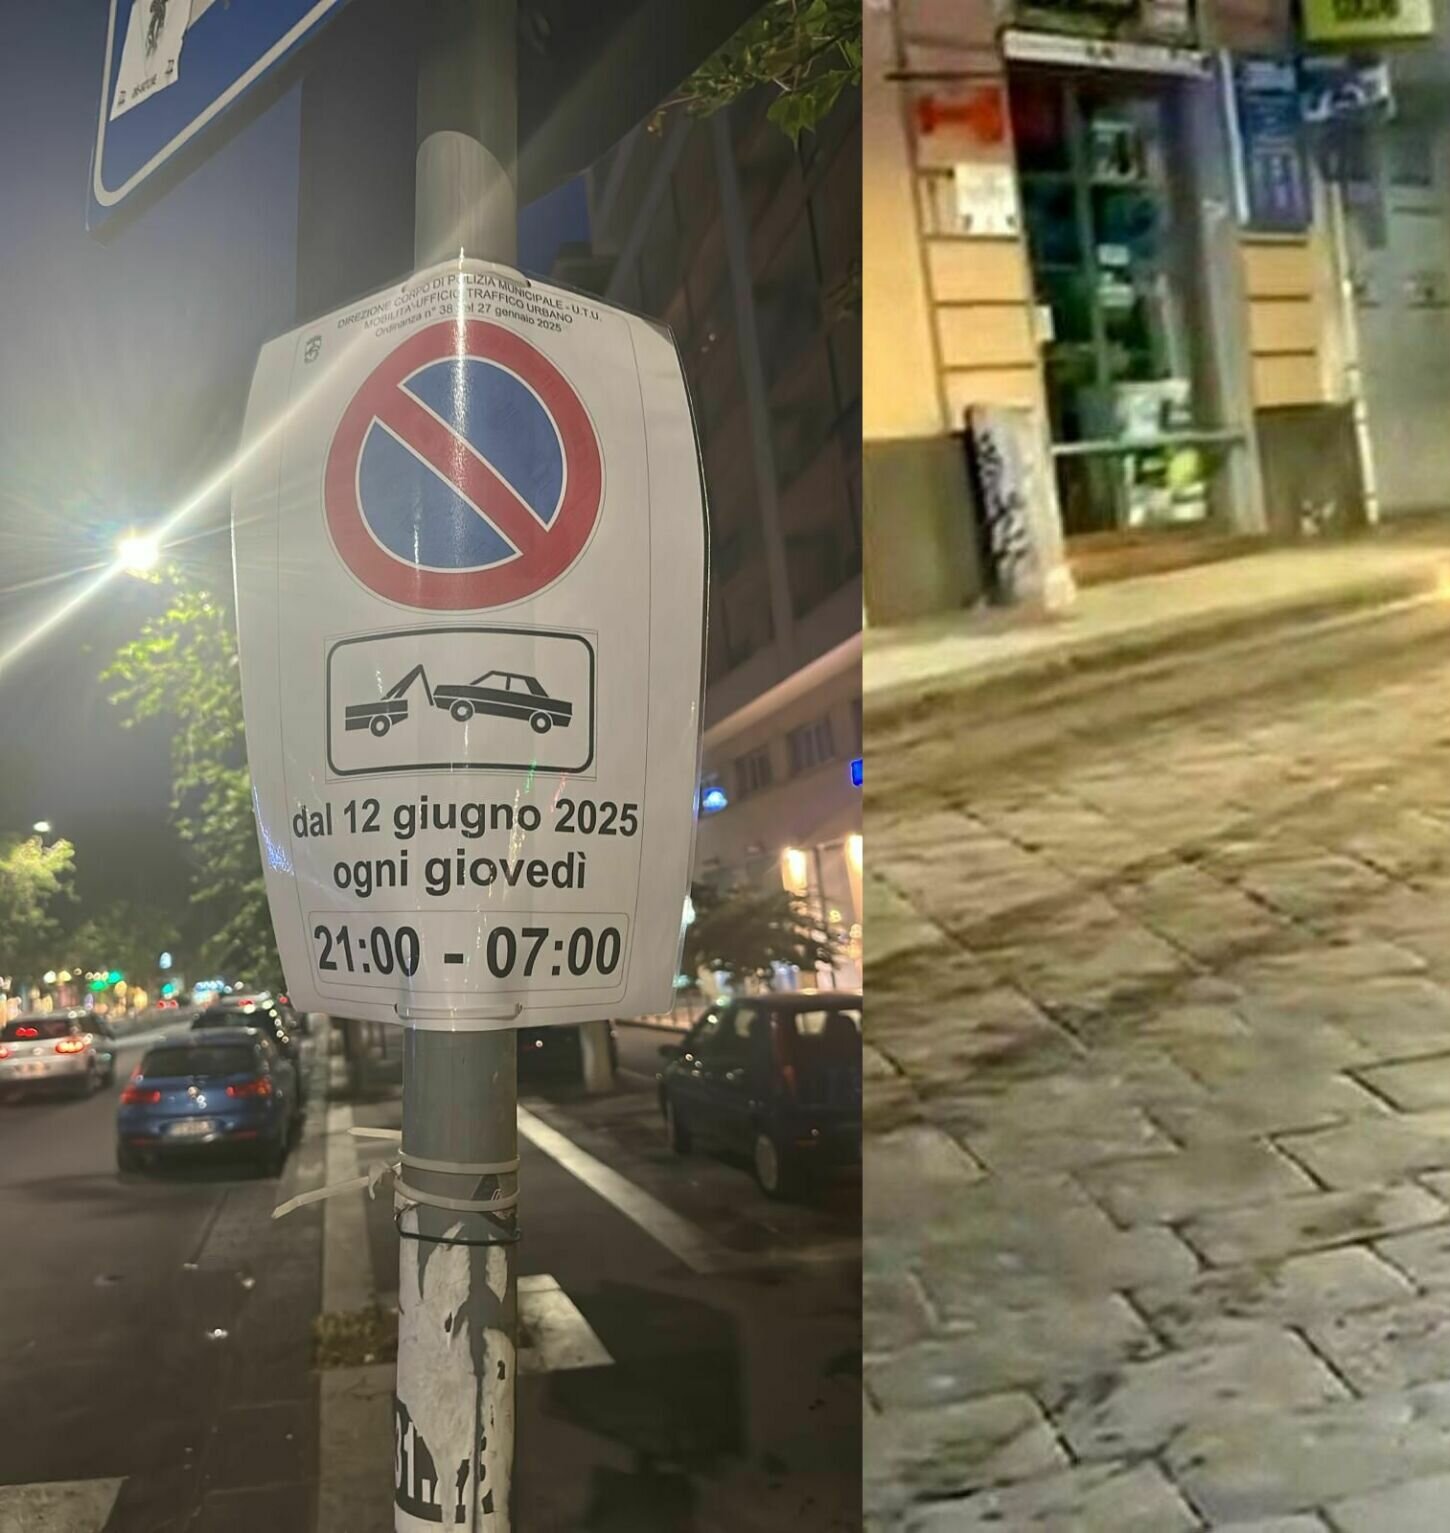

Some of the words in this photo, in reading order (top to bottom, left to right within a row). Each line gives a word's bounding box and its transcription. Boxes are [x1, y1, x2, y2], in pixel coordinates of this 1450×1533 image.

[337, 300, 391, 329] DIREZIONE
[394, 283, 430, 307] CORPO
[433, 277, 445, 289] DI
[498, 280, 563, 311] MUNICIPALE
[571, 305, 602, 322] U.T.U.
[375, 312, 421, 337] Ordinanza
[440, 303, 453, 316] 38
[478, 303, 492, 313] 27
[495, 306, 535, 325] gennaio
[537, 319, 562, 333] 2025
[467, 288, 524, 309] TRAFFICO
[526, 303, 573, 324] URBANO
[292, 802, 333, 838] dal
[343, 799, 381, 834] 12
[393, 795, 541, 840] giugno
[554, 798, 639, 837] 2025
[333, 850, 408, 898] ogni
[424, 848, 587, 897] giovedì
[313, 925, 421, 977] 21:00
[443, 953, 465, 964] -
[486, 926, 622, 978] 07:00
